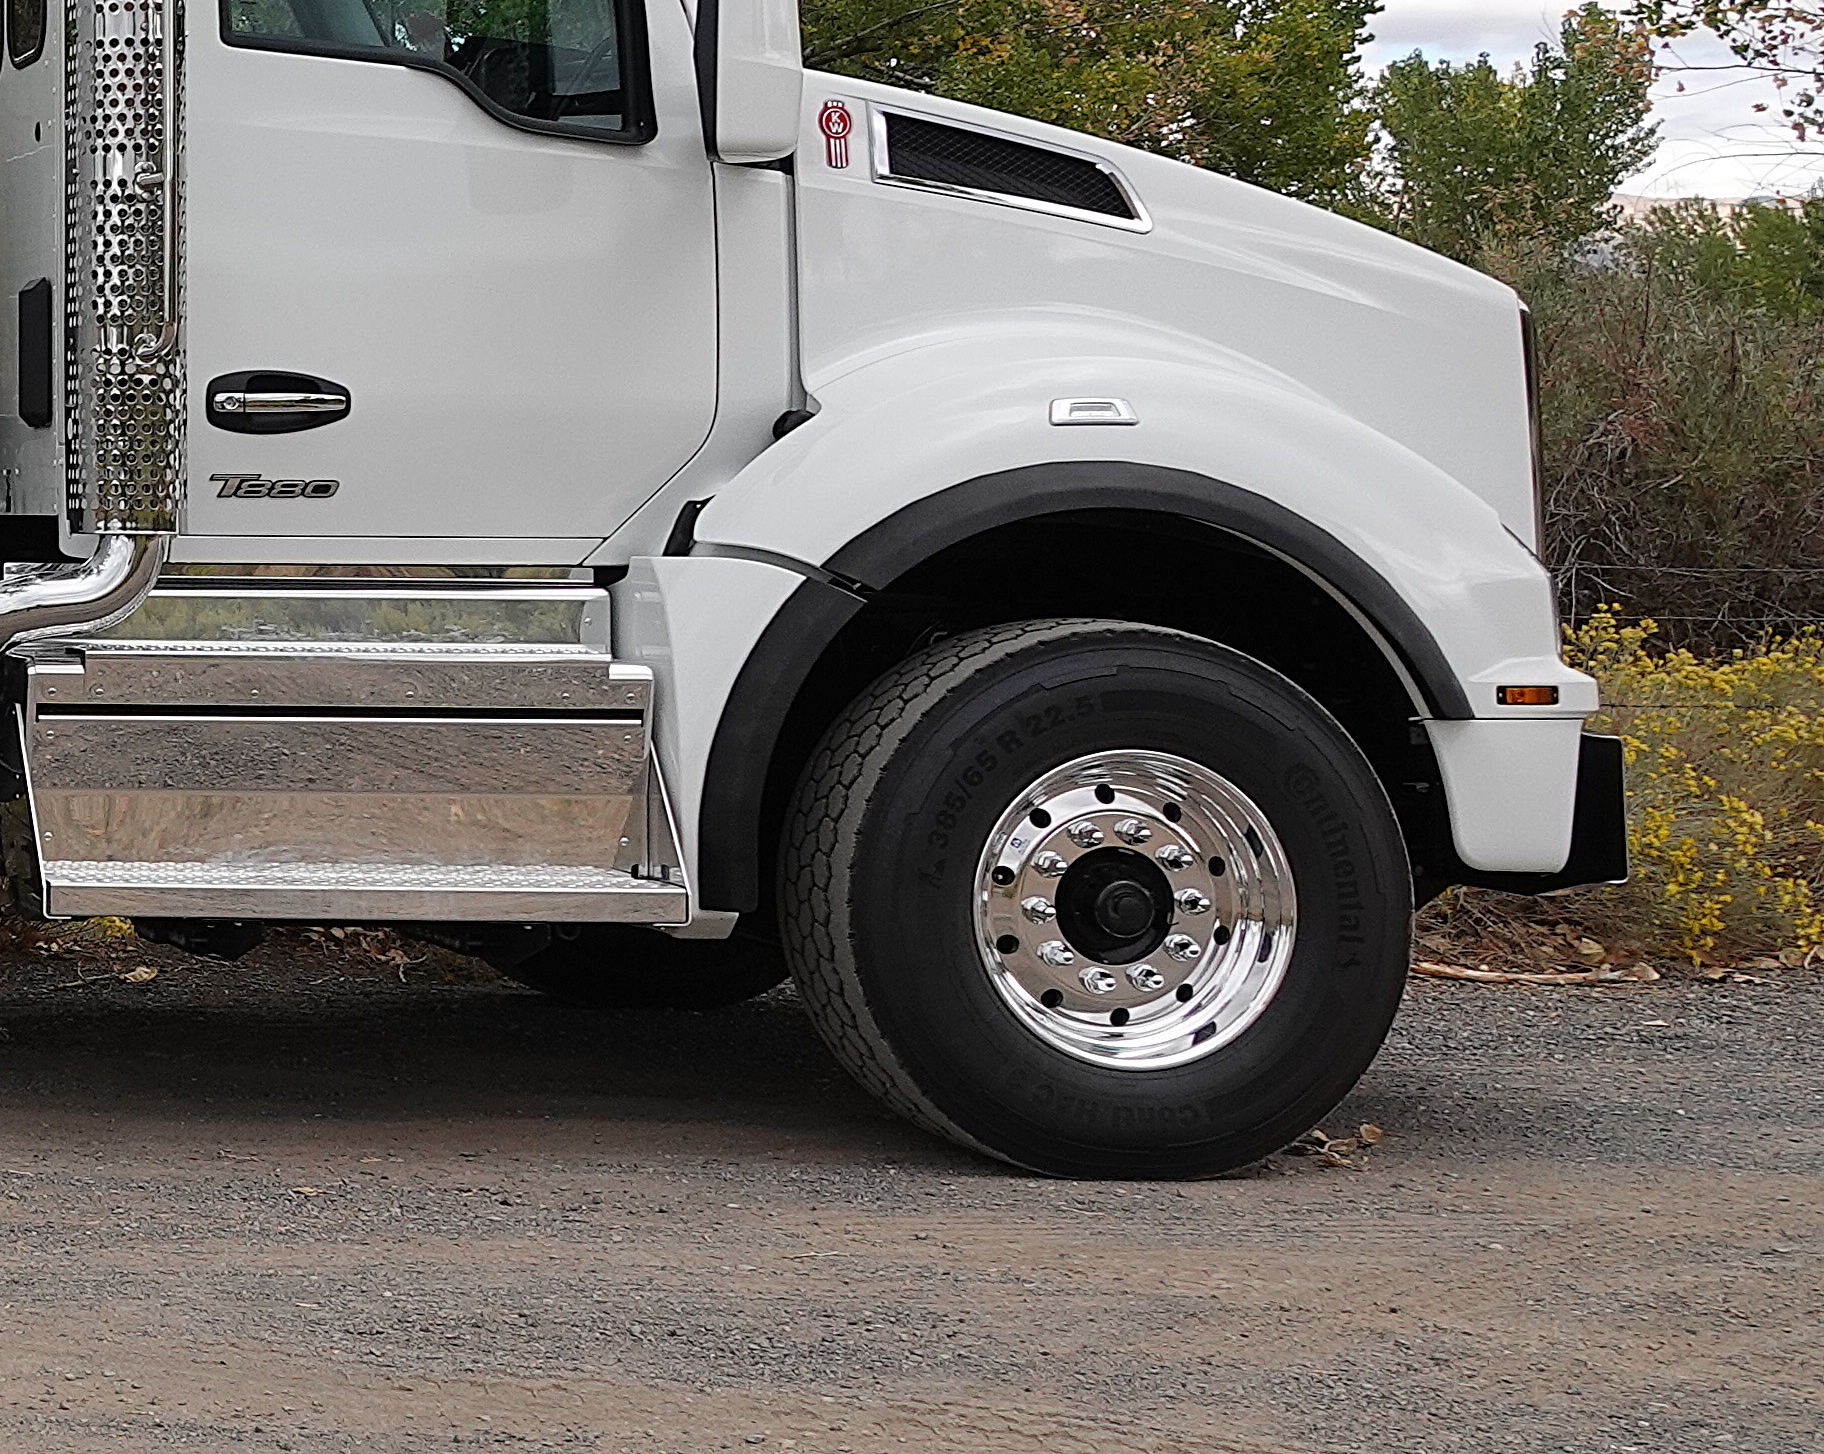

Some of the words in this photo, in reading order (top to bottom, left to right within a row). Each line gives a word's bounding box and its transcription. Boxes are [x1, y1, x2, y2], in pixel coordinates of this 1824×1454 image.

[209, 473, 340, 499] T880
[926, 749, 998, 850] 385/65
[994, 726, 1024, 757] R
[1021, 693, 1096, 740] 22.5
[1281, 760, 1364, 946] Continental
